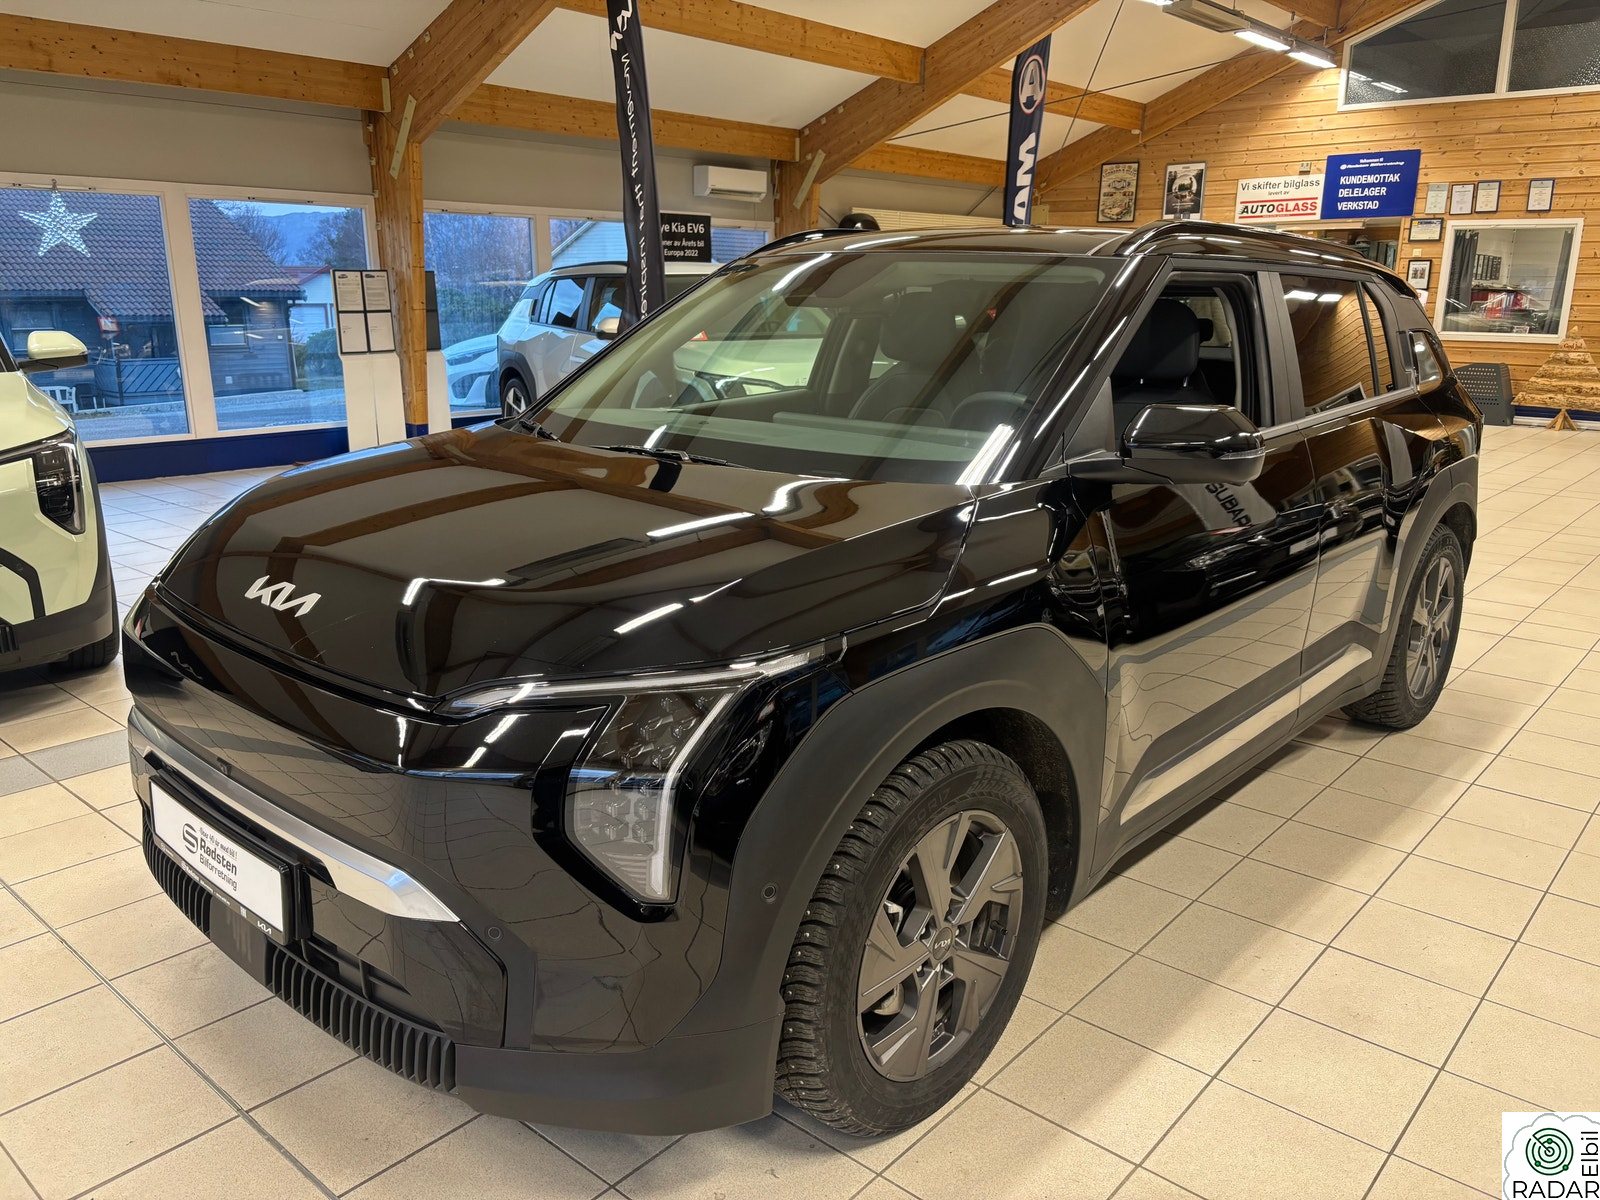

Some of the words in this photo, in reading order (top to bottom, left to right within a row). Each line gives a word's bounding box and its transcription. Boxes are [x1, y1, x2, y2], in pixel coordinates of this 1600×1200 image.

[1241, 182, 1250, 191] Vi
[1252, 181, 1281, 191] skifter
[1283, 179, 1321, 190] bilglass
[1340, 173, 1401, 185] KUNDEMOTTAK
[1338, 187, 1387, 198] DELELAGER
[1240, 201, 1318, 215] AUTOGLASS
[1337, 200, 1379, 211] VERKSTAD
[661, 223, 670, 234] ye
[671, 222, 686, 233] Kia
[687, 223, 705, 234] EV6
[664, 248, 684, 257] Europa
[684, 249, 699, 257] 2022
[1205, 483, 1252, 527] SUBAR
[244, 574, 321, 617] KIA
[200, 853, 237, 891] Bilforretning
[257, 920, 272, 935] KIA
